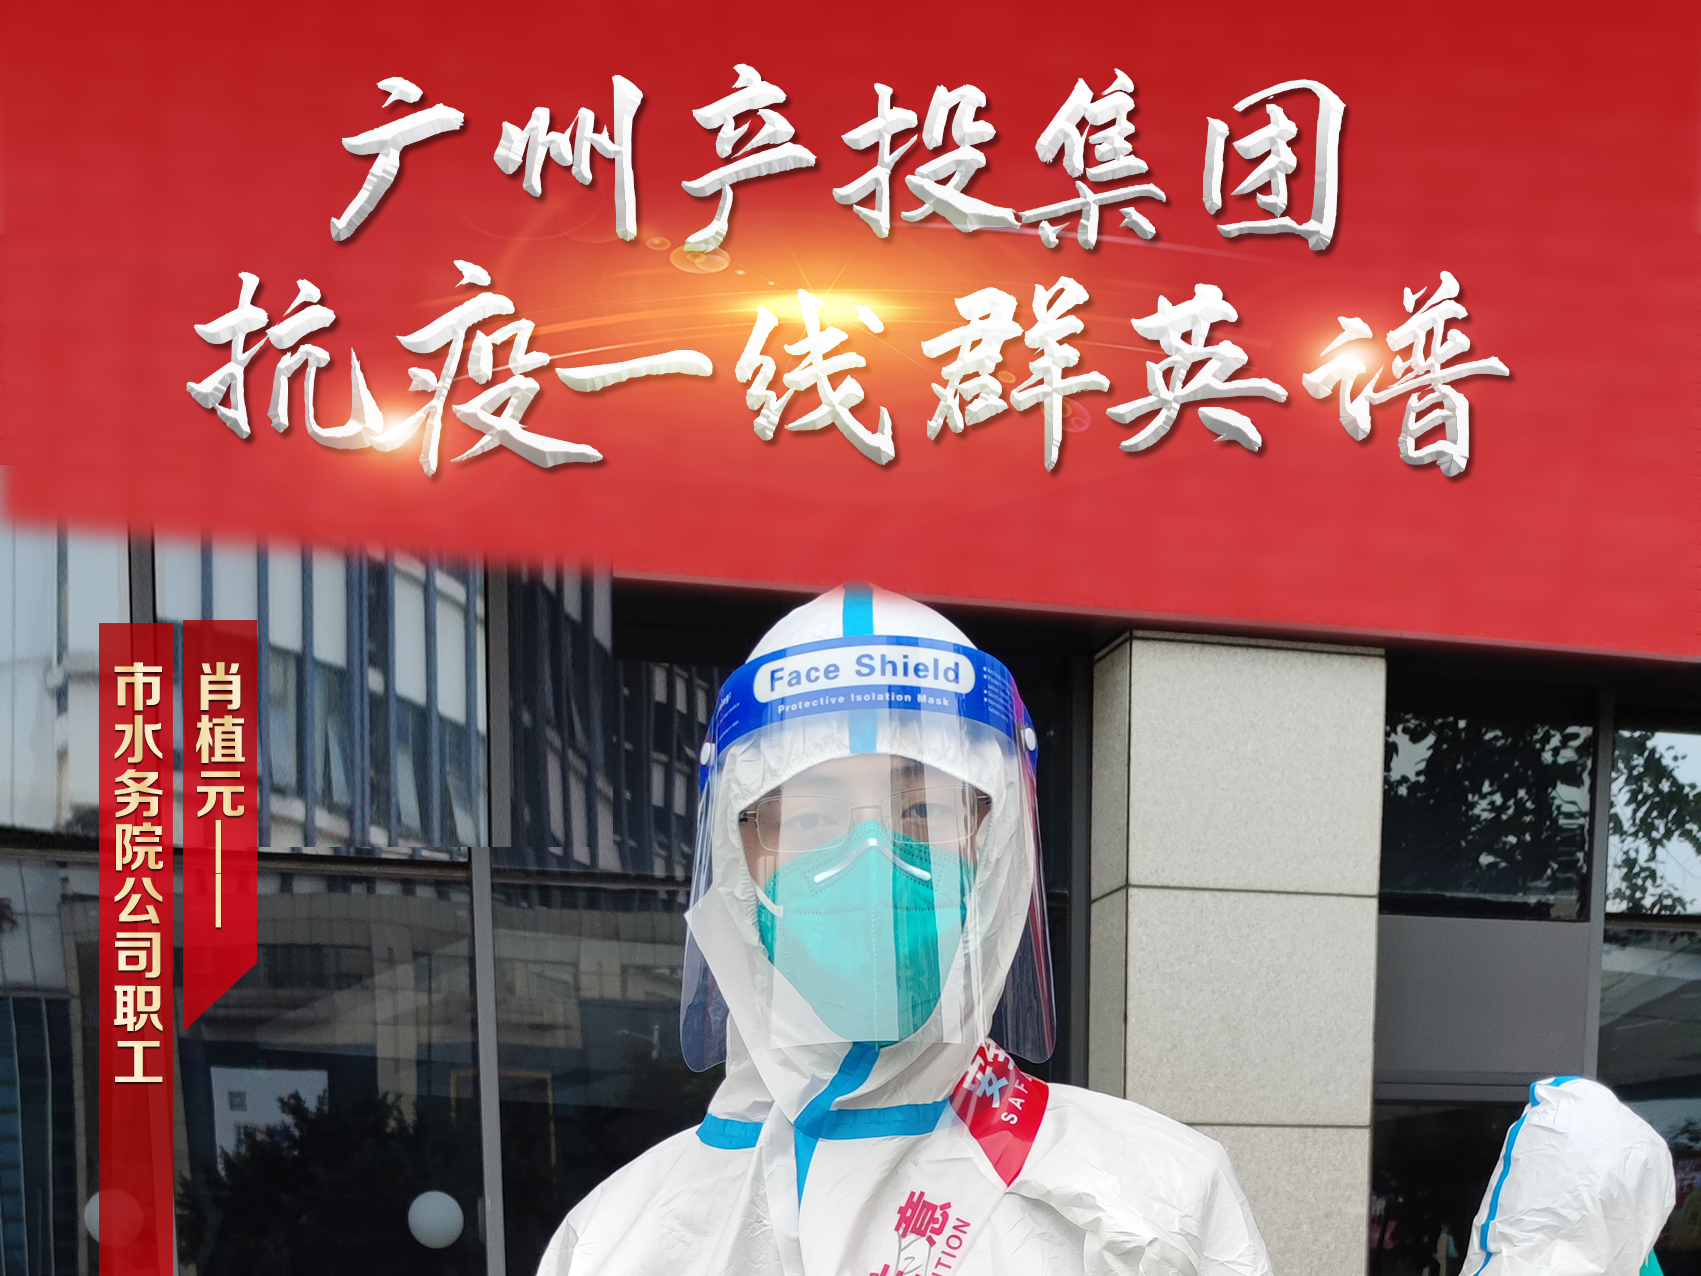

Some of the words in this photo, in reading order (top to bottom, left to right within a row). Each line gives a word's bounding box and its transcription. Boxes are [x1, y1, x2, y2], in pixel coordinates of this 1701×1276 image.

[770, 663, 841, 693] Face
[855, 653, 960, 685] Shield
[778, 695, 845, 715] Protective
[851, 692, 912, 702] Isolation
[917, 693, 950, 706] Mask
